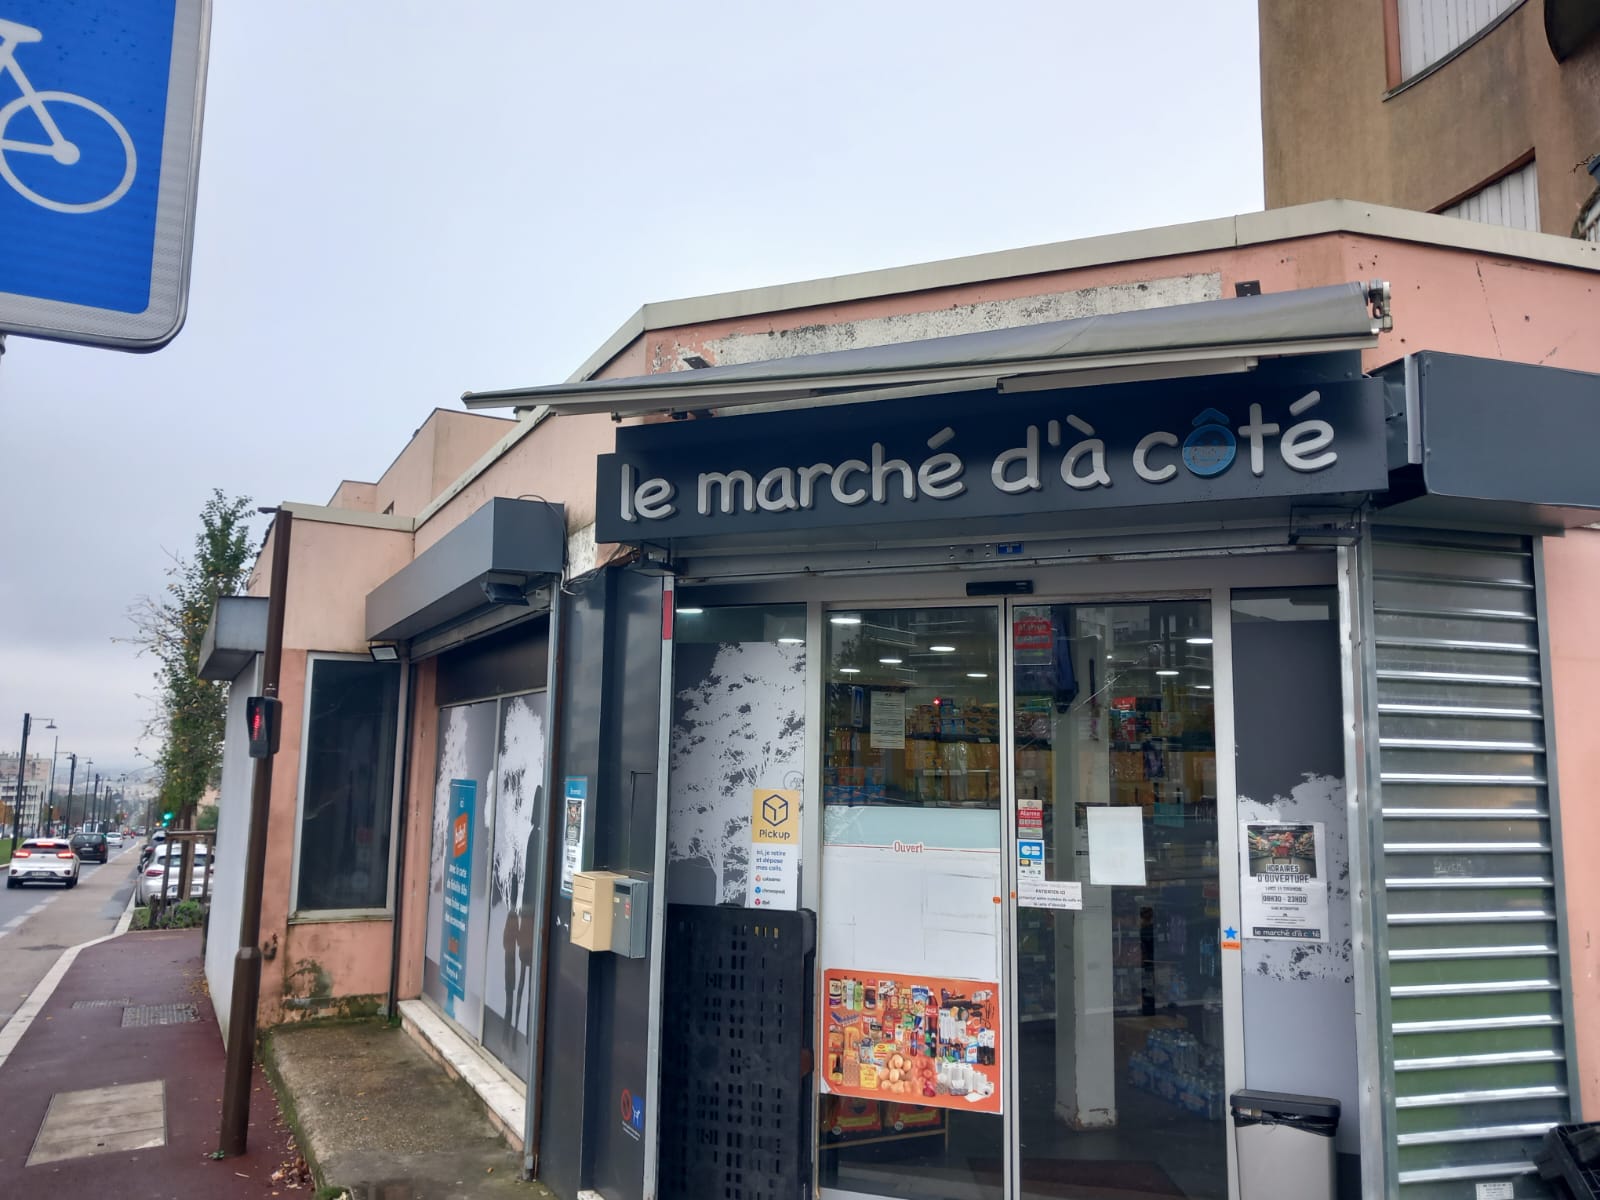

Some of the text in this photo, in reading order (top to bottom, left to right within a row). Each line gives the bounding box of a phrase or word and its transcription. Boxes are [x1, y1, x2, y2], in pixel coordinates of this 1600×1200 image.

[620, 390, 1339, 521] le marché d'à côté
[759, 829, 790, 840] Pickup
[894, 841, 923, 853] Ouvert
[1266, 864, 1299, 873] HORAIRES
[1257, 874, 1309, 883] D'OUVERTURE
[1263, 928, 1290, 937] marché
